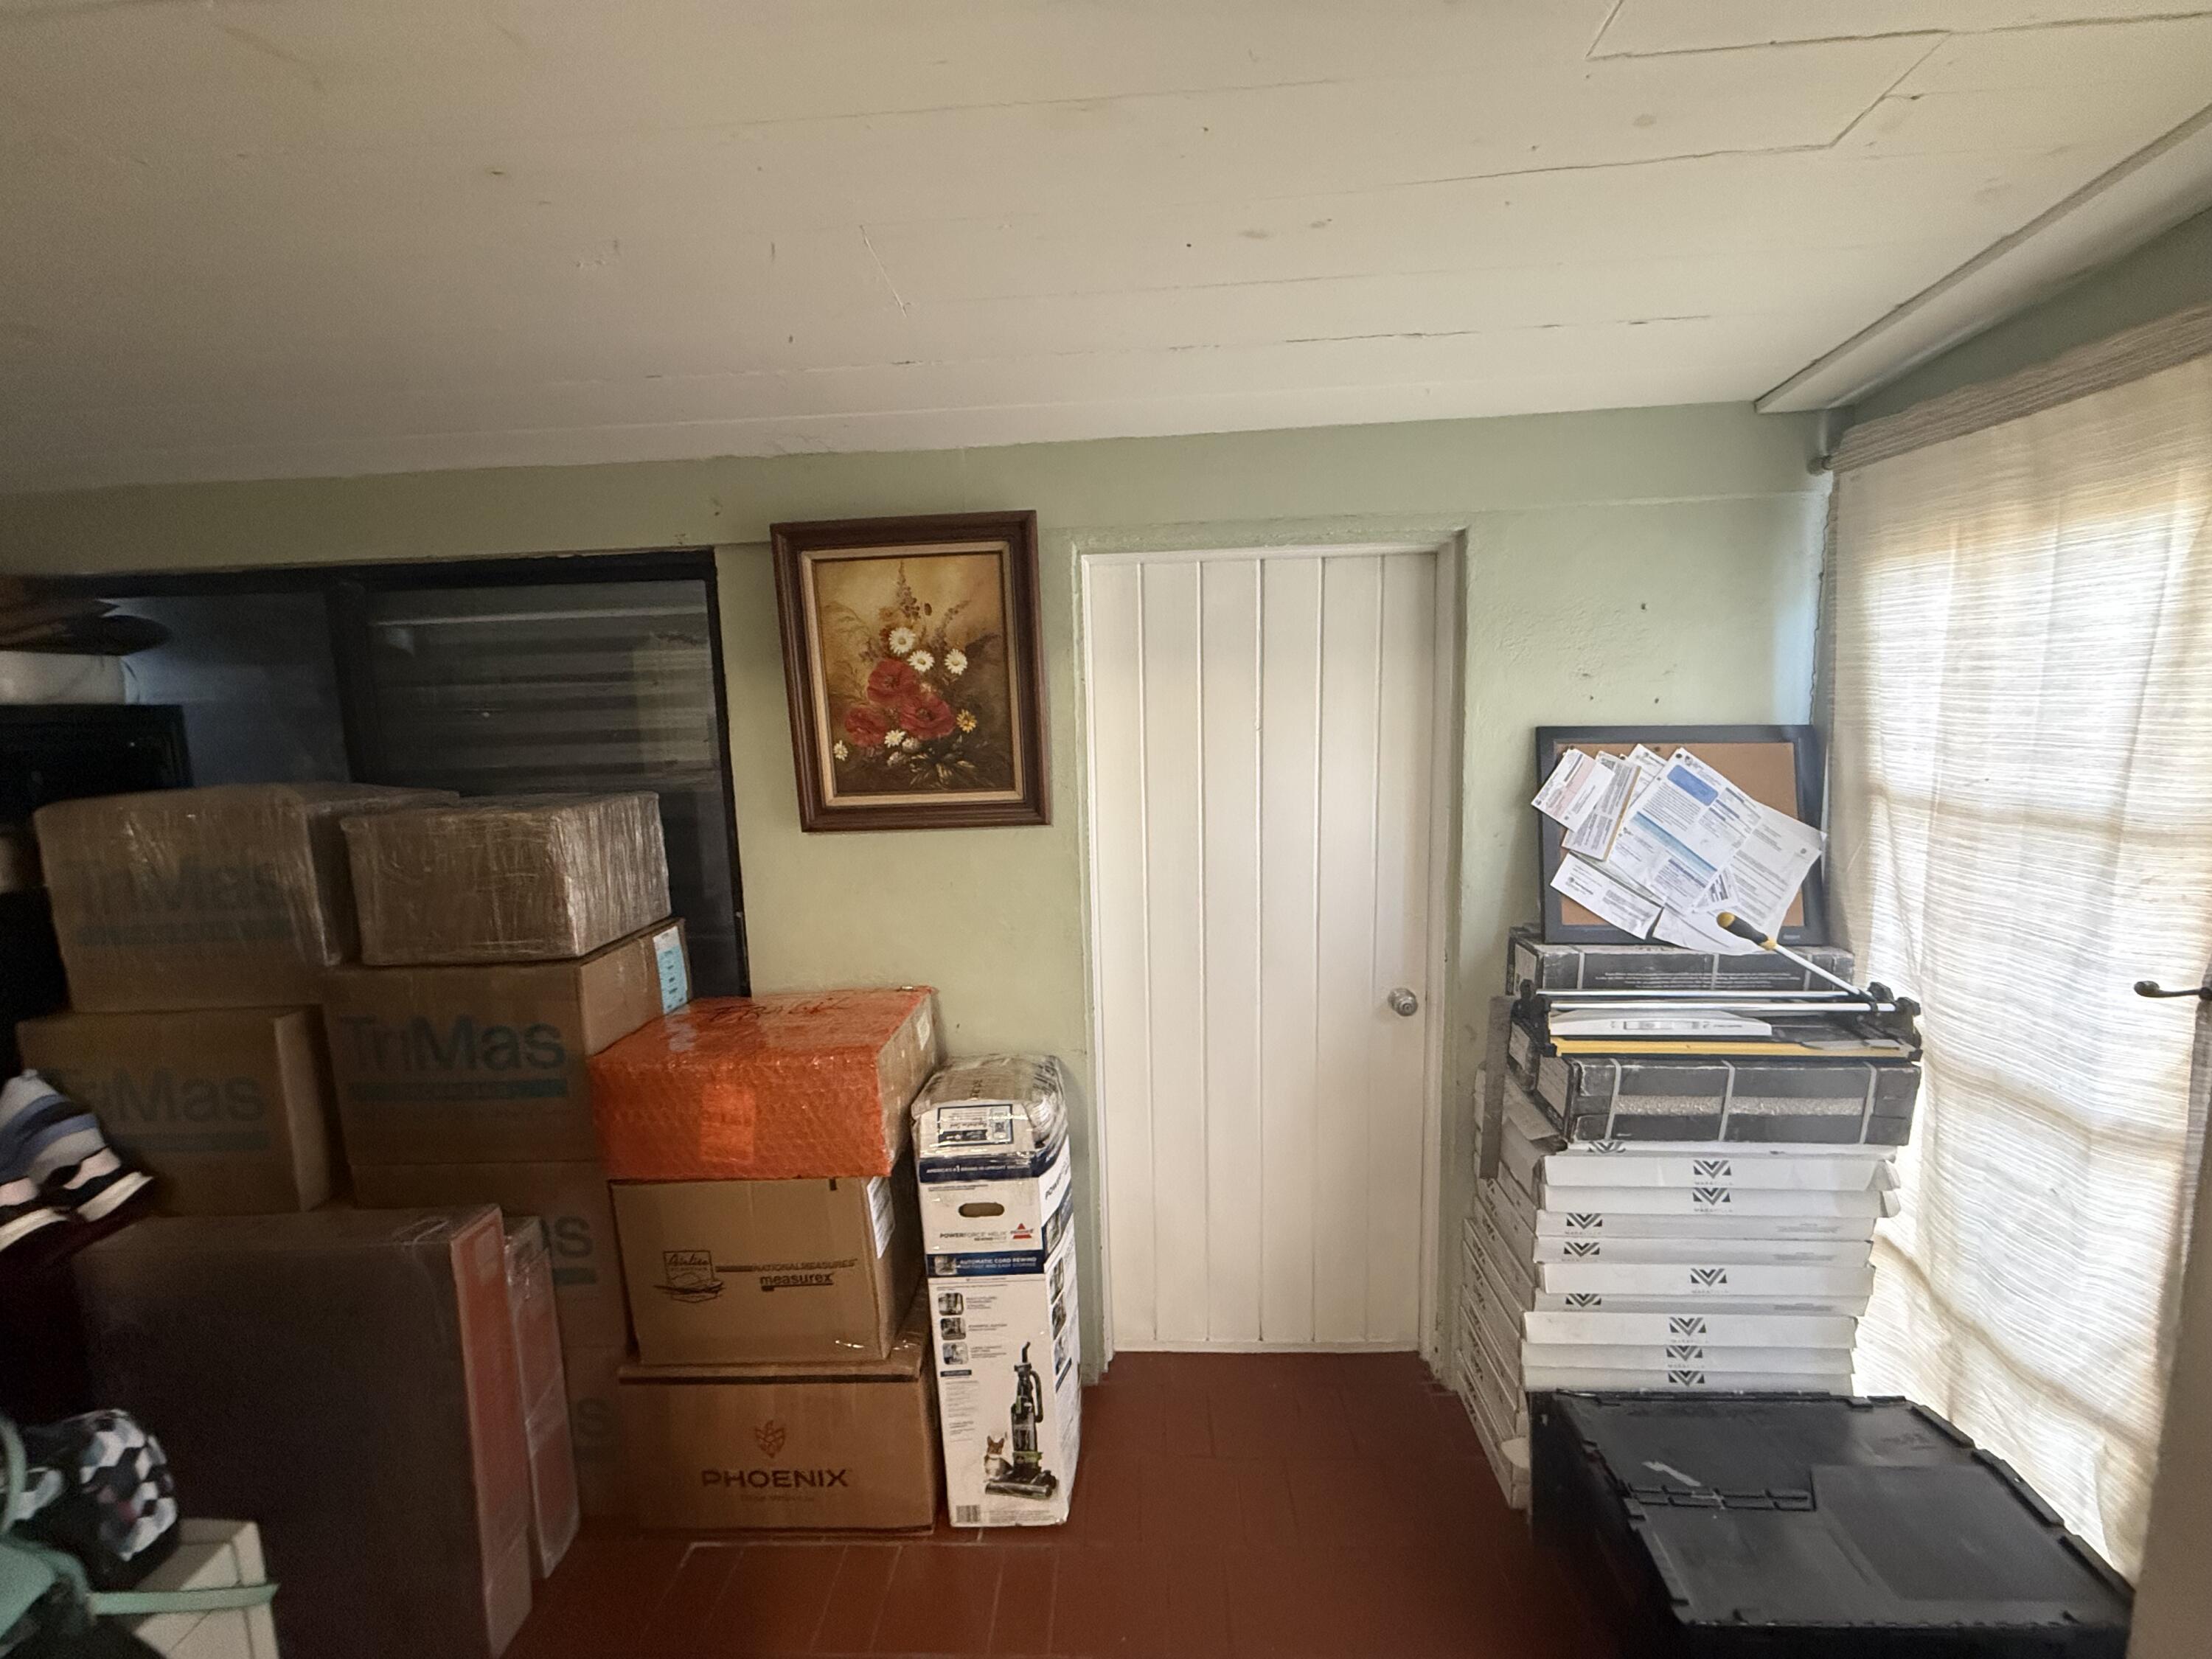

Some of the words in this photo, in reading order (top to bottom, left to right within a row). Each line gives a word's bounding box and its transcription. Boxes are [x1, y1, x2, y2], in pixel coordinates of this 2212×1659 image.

[340, 1014, 566, 1071] TriMas
[759, 1273, 835, 1285] measurex
[701, 1469, 849, 1488] PHOENIX
